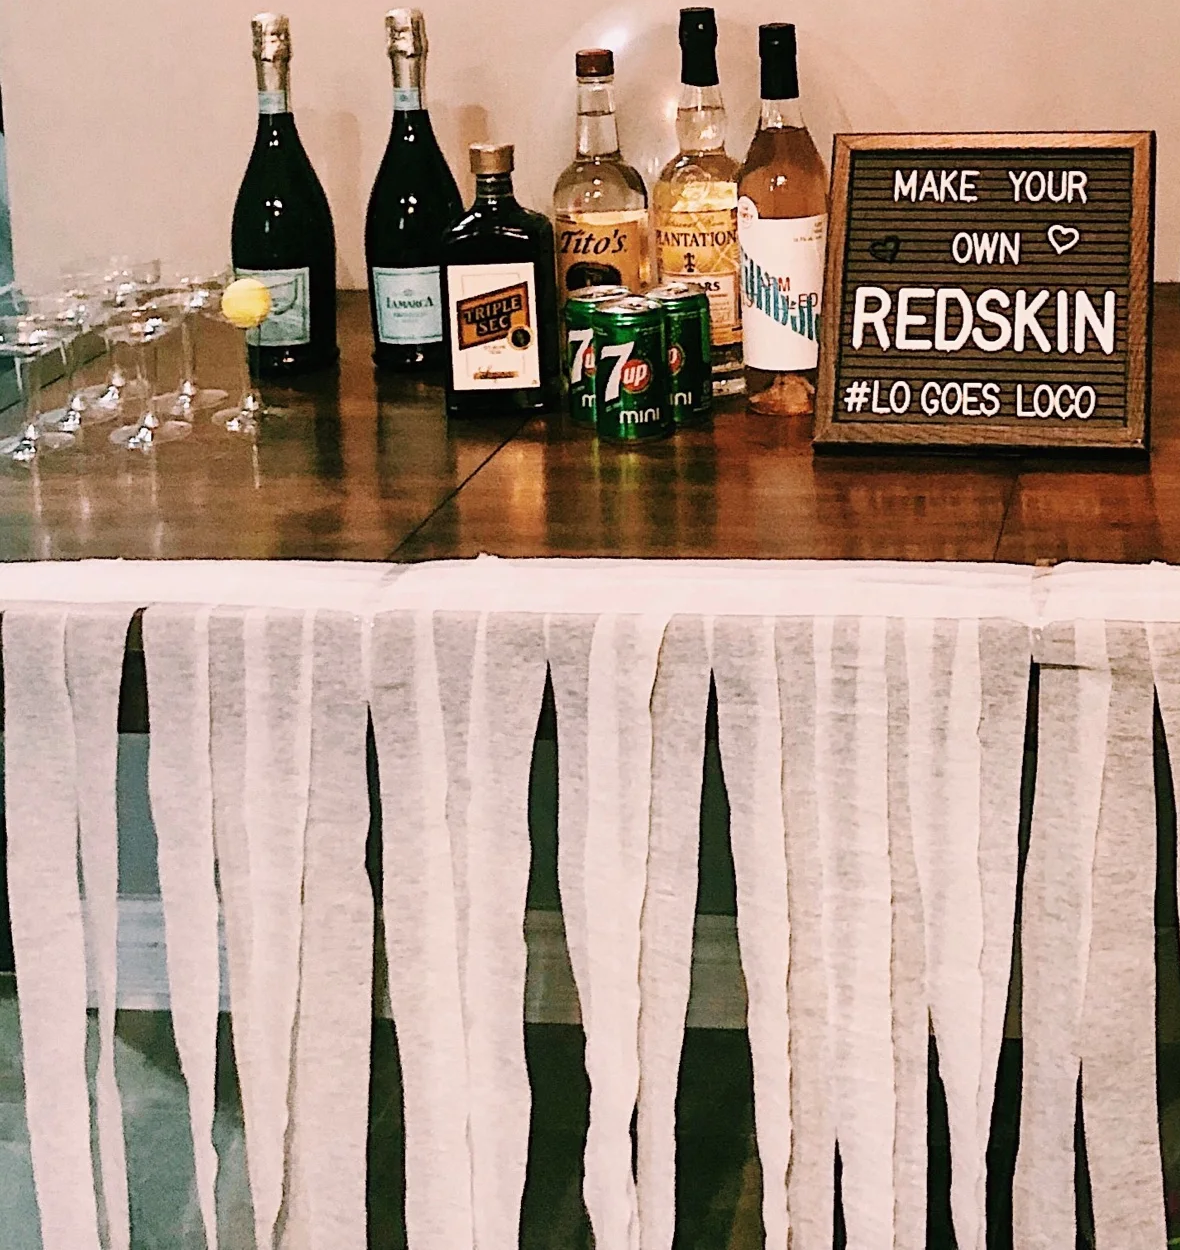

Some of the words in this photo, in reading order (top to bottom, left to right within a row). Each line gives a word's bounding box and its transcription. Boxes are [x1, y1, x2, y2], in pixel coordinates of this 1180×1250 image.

[894, 169, 980, 203] MAKE
[1008, 170, 1088, 204] YOUR
[560, 229, 628, 255] Tito's
[952, 231, 1021, 265] OWN
[464, 296, 520, 323] TRIPLE
[852, 286, 1115, 356] REDSKIN
[478, 316, 509, 335] SEC
[844, 380, 911, 415] #LO
[921, 381, 1001, 417] GOES
[1016, 384, 1096, 419] LOCO
[619, 407, 660, 424] mini
